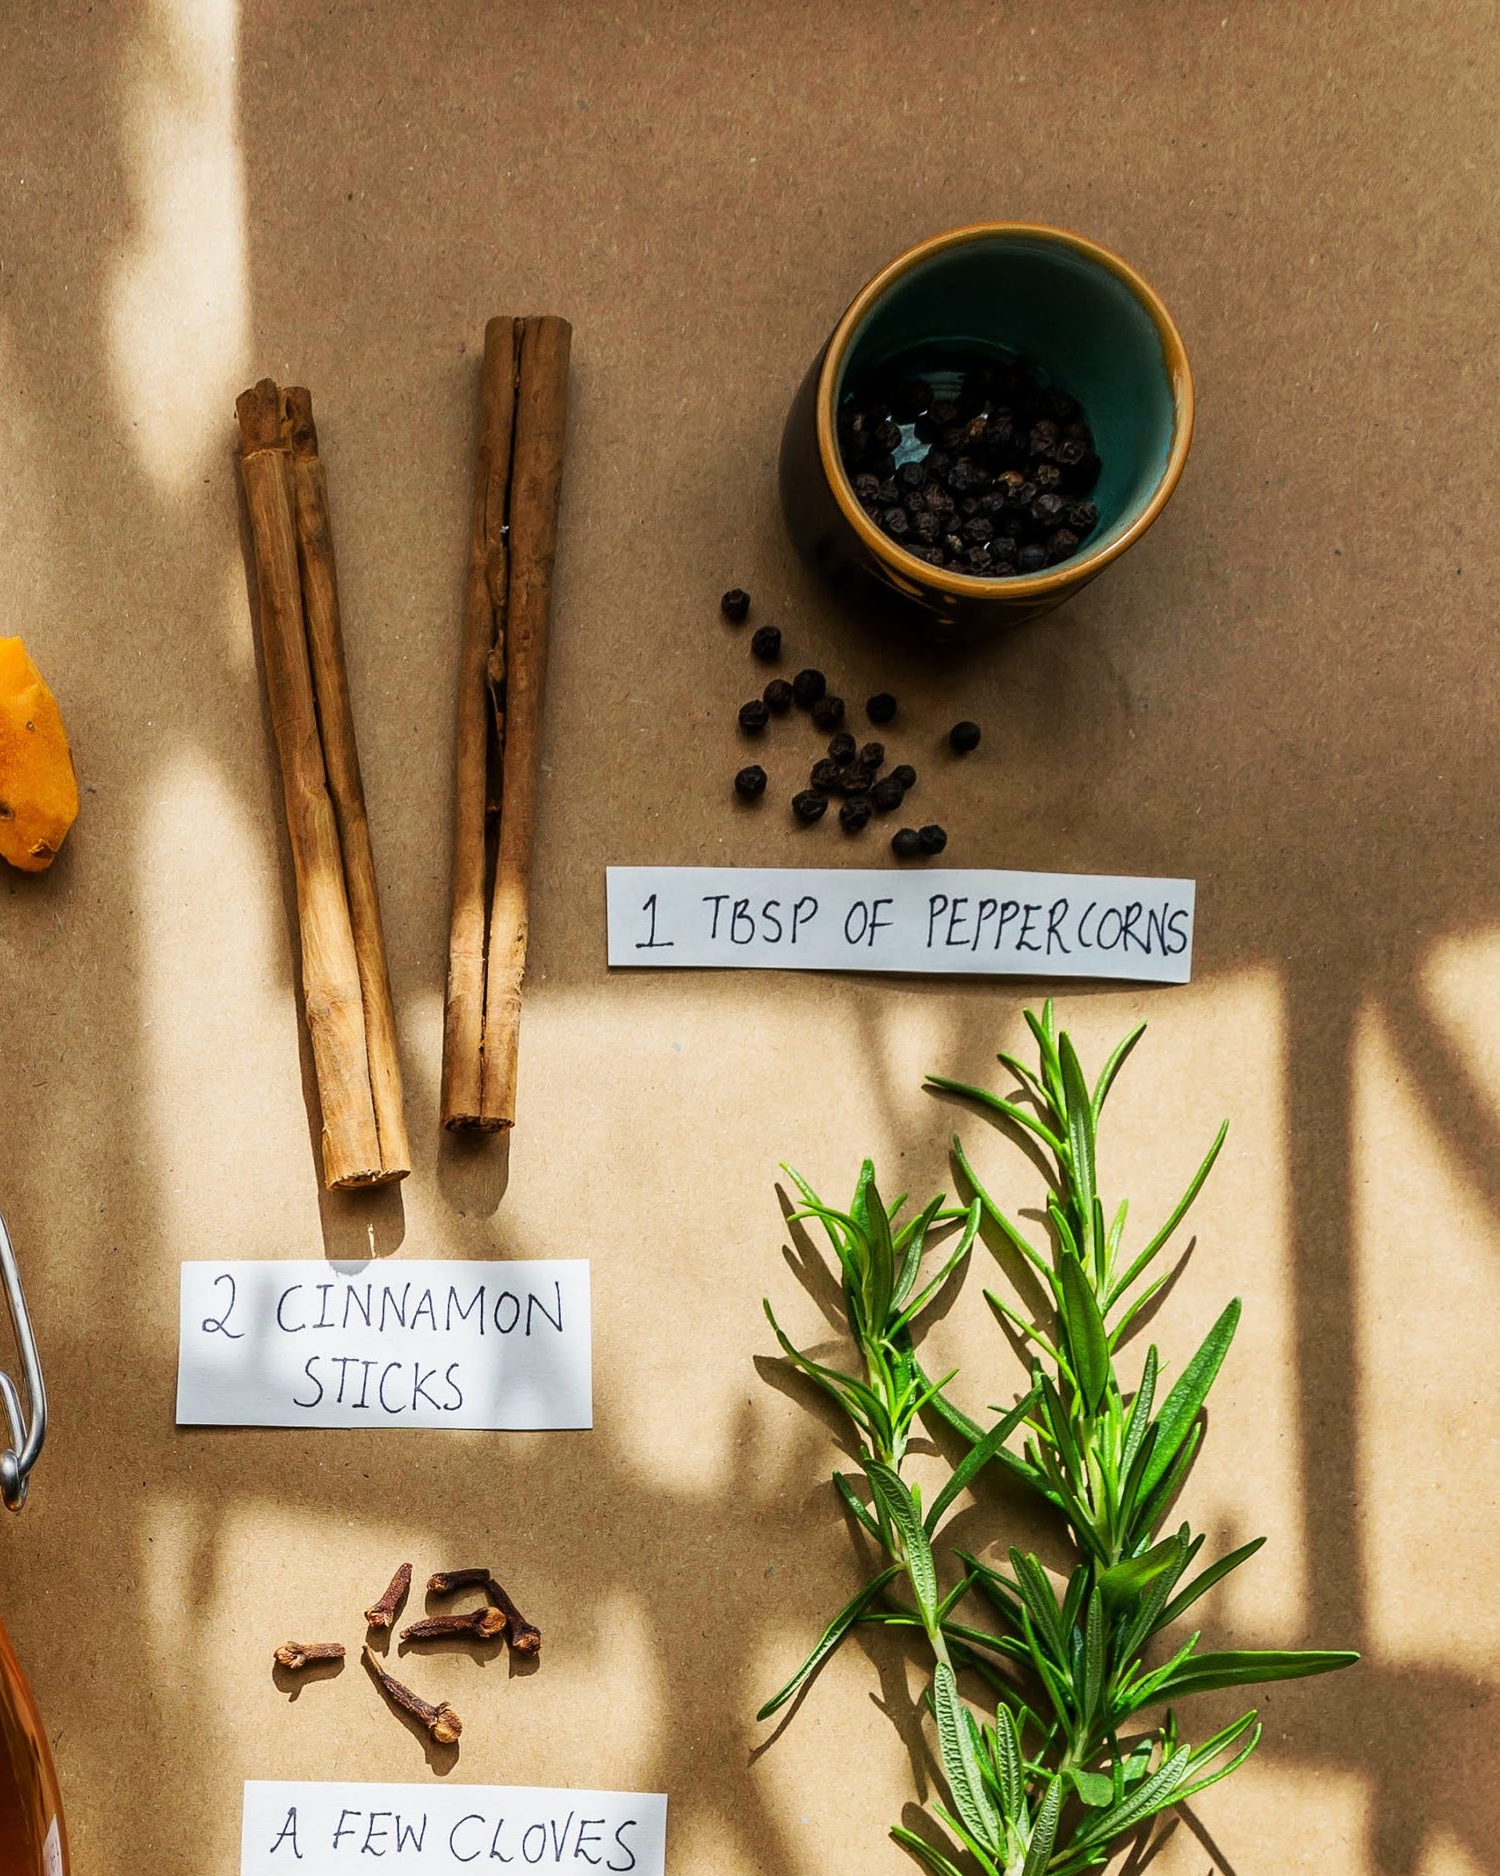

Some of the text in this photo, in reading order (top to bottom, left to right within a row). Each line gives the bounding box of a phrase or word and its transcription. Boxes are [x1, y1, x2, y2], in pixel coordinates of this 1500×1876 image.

[634, 893, 1189, 957] 1 TBSP OF PEPPERCORNS
[201, 1273, 564, 1339] 2 CINNAMON
[292, 1355, 463, 1414] STICKS
[269, 1806, 637, 1872] A FEW CLOVES
